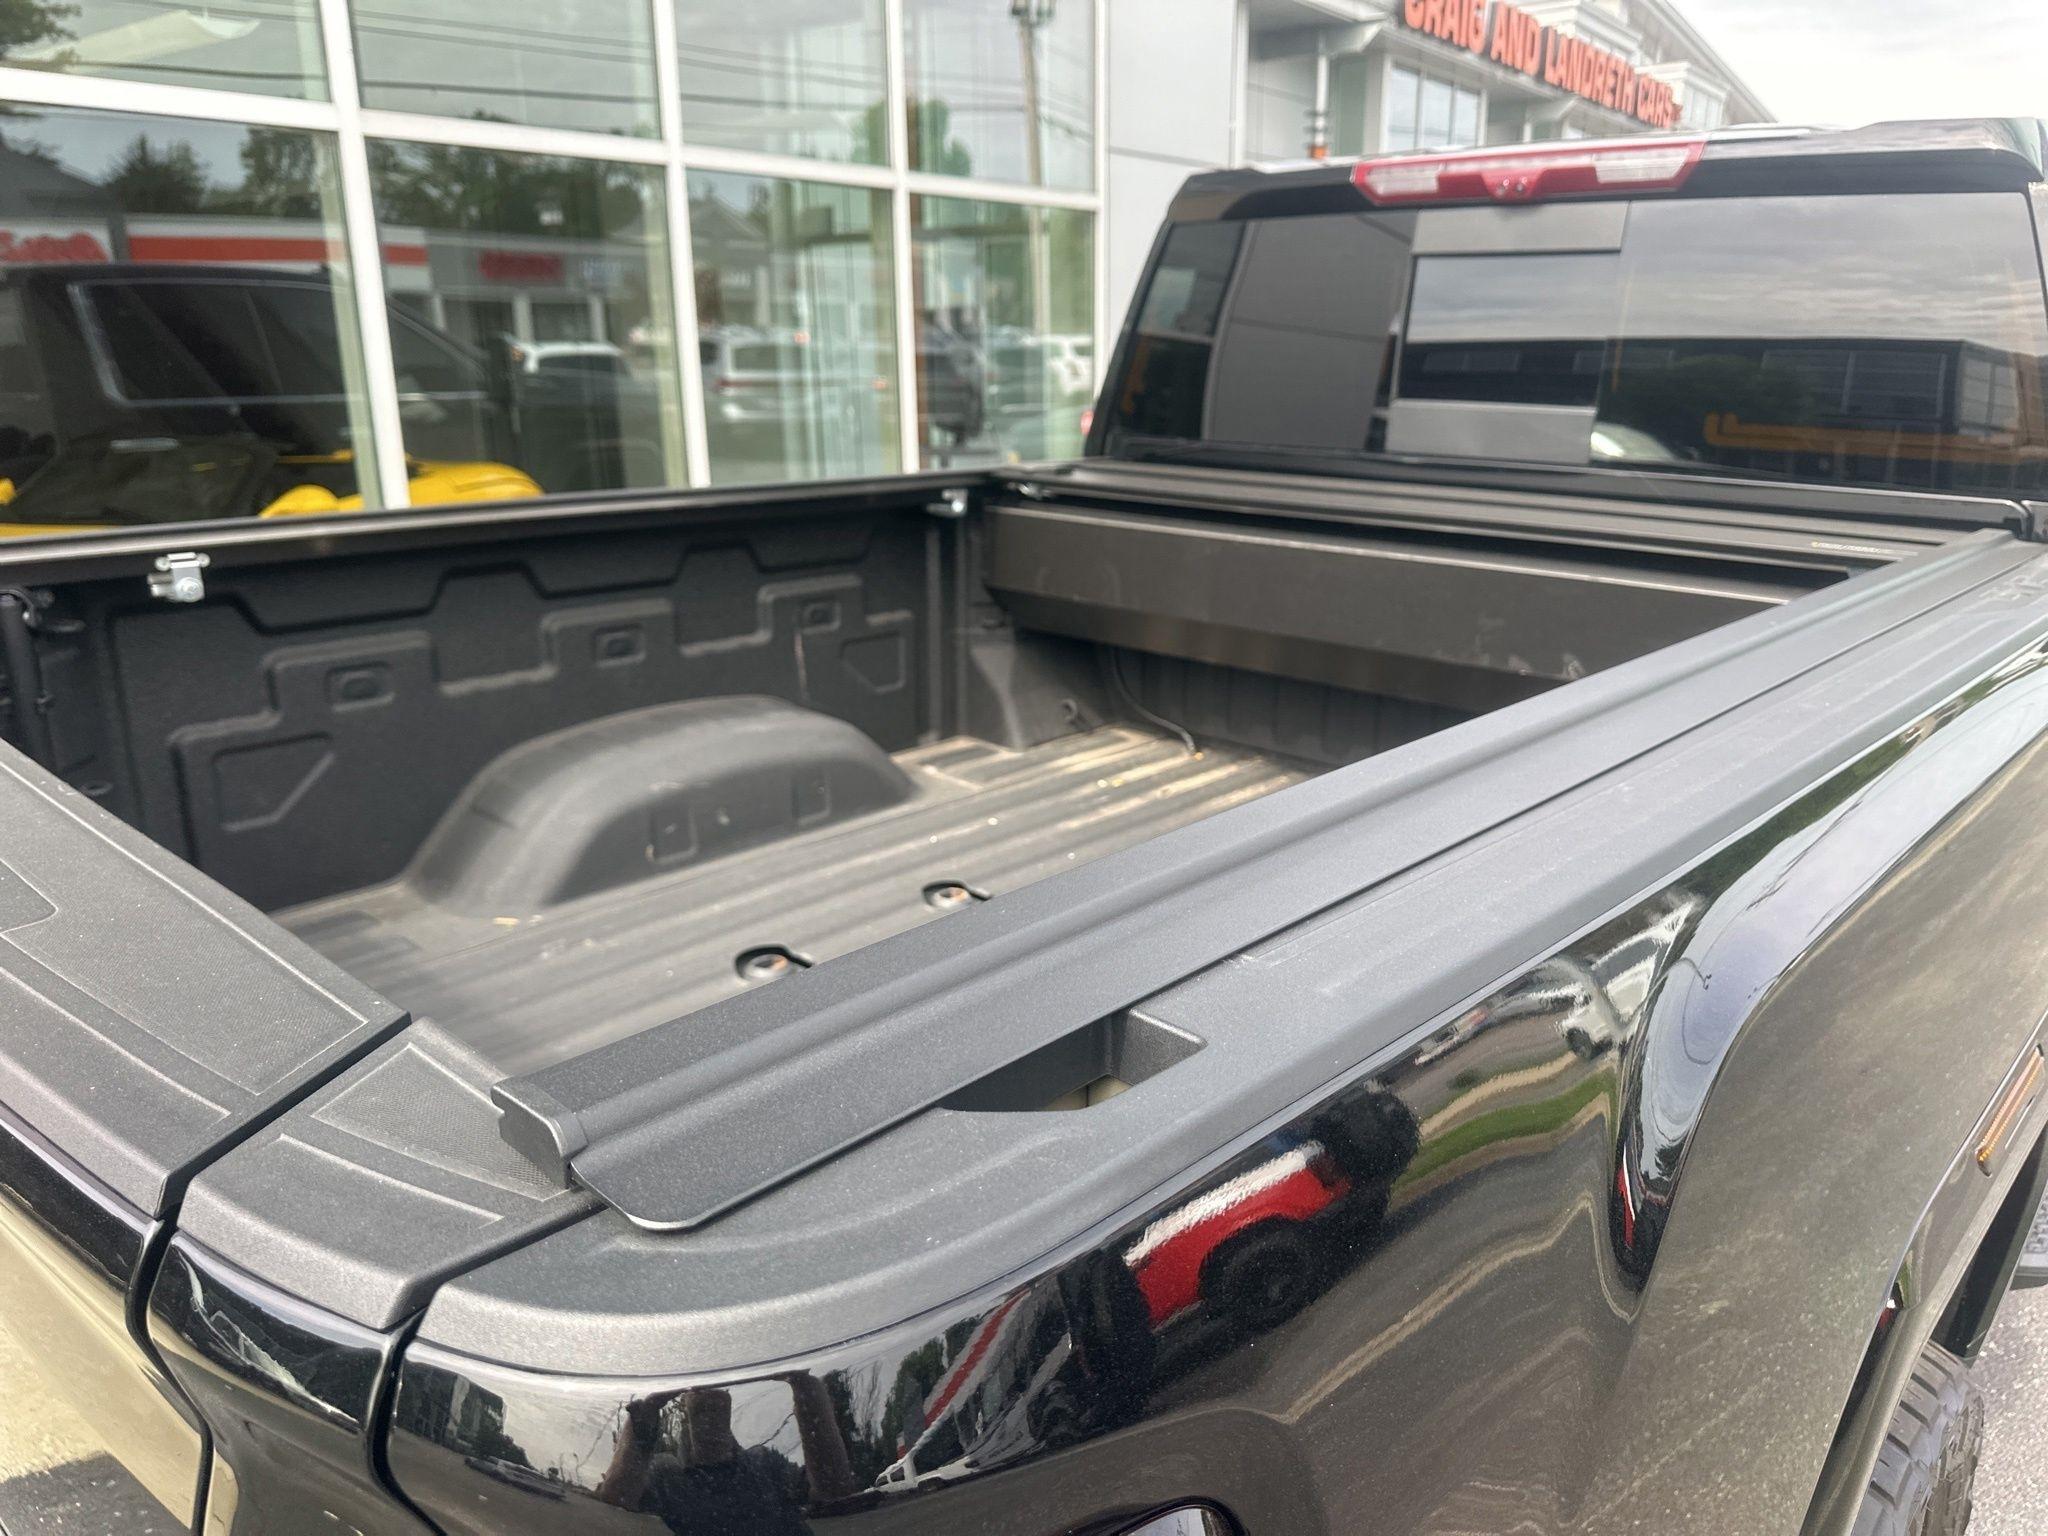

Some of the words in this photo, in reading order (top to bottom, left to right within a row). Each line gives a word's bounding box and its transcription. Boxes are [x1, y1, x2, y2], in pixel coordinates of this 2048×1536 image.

[1490, 2, 1541, 76] AND
[1544, 26, 1636, 115] LANDRETH
[1637, 73, 1675, 128] CARS
